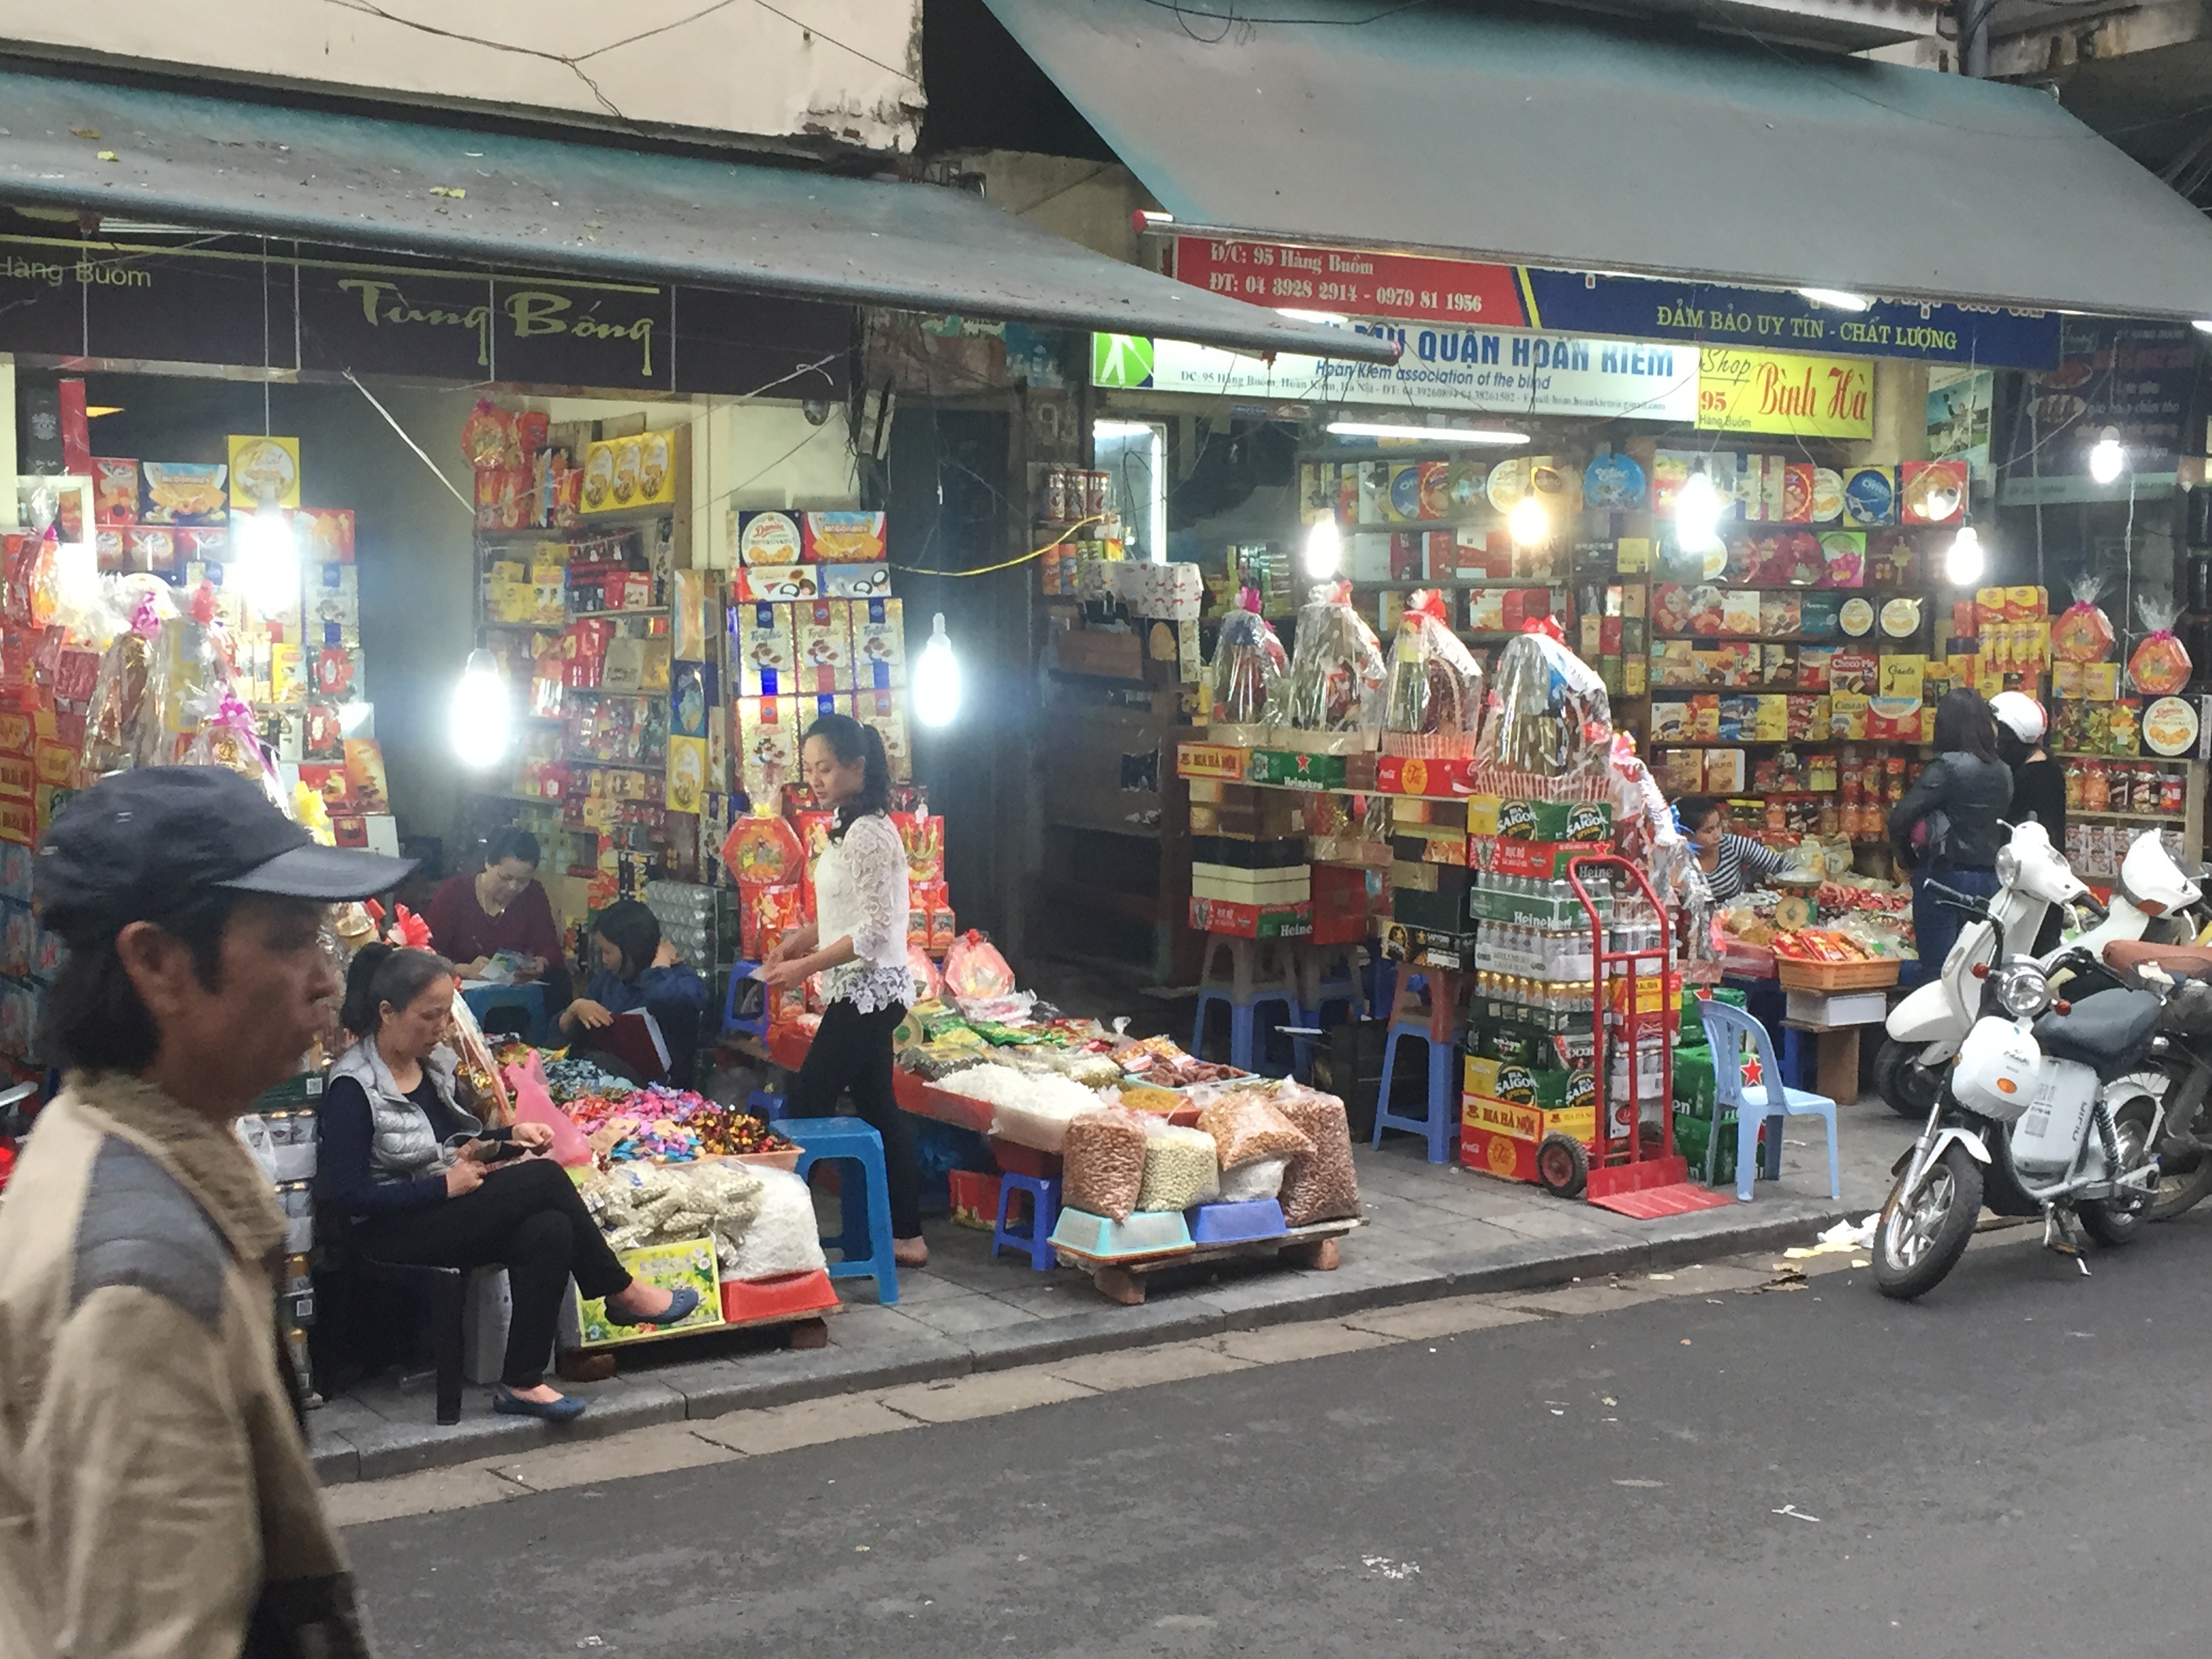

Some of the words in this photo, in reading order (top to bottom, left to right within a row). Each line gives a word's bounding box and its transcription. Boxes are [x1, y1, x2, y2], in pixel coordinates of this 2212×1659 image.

[1254, 247, 1275, 266] 95
[1280, 248, 1322, 274] Hàng
[1329, 253, 1374, 275] Buồm
[1210, 272, 1239, 292] ĐT:
[1245, 275, 1266, 294] 04
[1272, 277, 1313, 298] 3928
[1319, 282, 1357, 302] 2914
[1376, 286, 1414, 307] 0979
[1420, 291, 1438, 309] 81
[1445, 293, 1482, 312] 1956
[337, 279, 491, 366] Tùng
[1656, 298, 1704, 330] ĐẢM
[1711, 303, 1752, 333] BẢO
[1758, 314, 1785, 337] UY
[1790, 312, 1824, 339] TÍN
[1840, 316, 1890, 345] CHẤT
[1895, 326, 1957, 352] LƯỢNG
[1418, 329, 1500, 369] QUẬN
[1316, 360, 1355, 377] Hoan
[1396, 367, 1475, 386] association
[1477, 371, 1491, 386] of
[1518, 373, 1551, 390] blind
[1701, 348, 1750, 386] Shop
[1700, 390, 1727, 411] 95
[1757, 361, 1817, 417] Bình
[1828, 367, 1868, 421] Hà
[1832, 659, 1860, 668] Choco
[1284, 775, 1323, 789] Heineken
[1496, 811, 1540, 832] SAIGON
[1566, 815, 1608, 838] SAIGON
[1495, 1078, 1540, 1096] SAIGON
